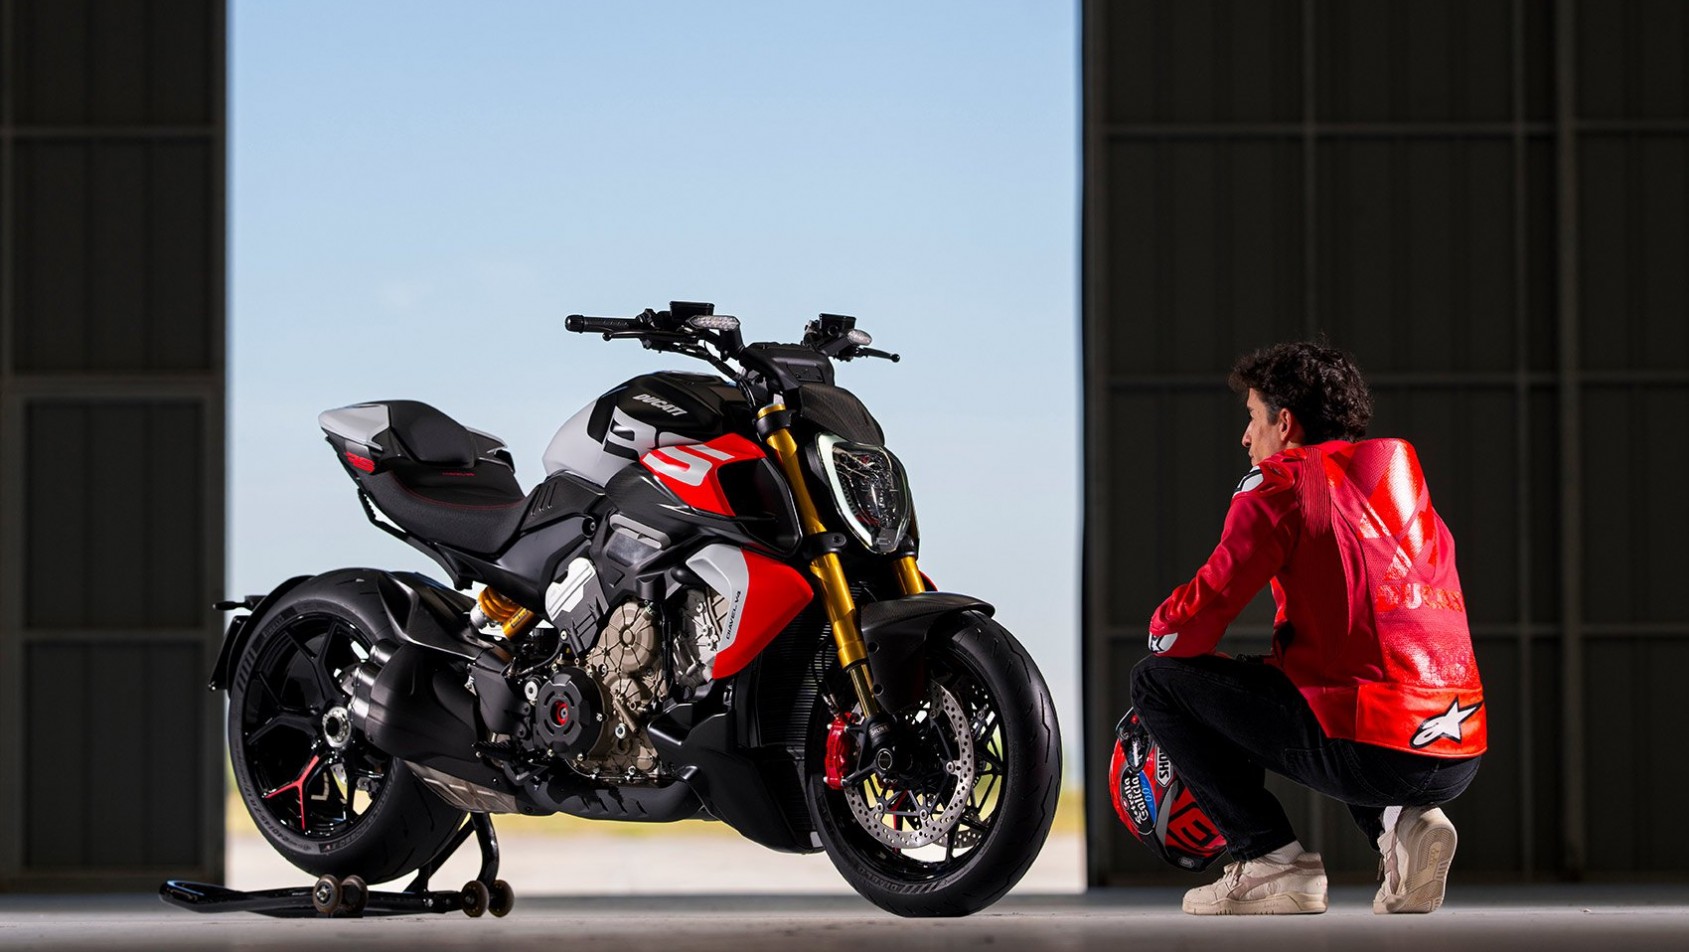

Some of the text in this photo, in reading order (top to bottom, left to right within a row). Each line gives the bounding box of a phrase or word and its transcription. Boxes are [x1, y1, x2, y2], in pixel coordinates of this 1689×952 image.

[632, 394, 688, 416] DUCATI
[726, 590, 741, 640] DIAVEL V4
[1131, 776, 1149, 821] Galicia
